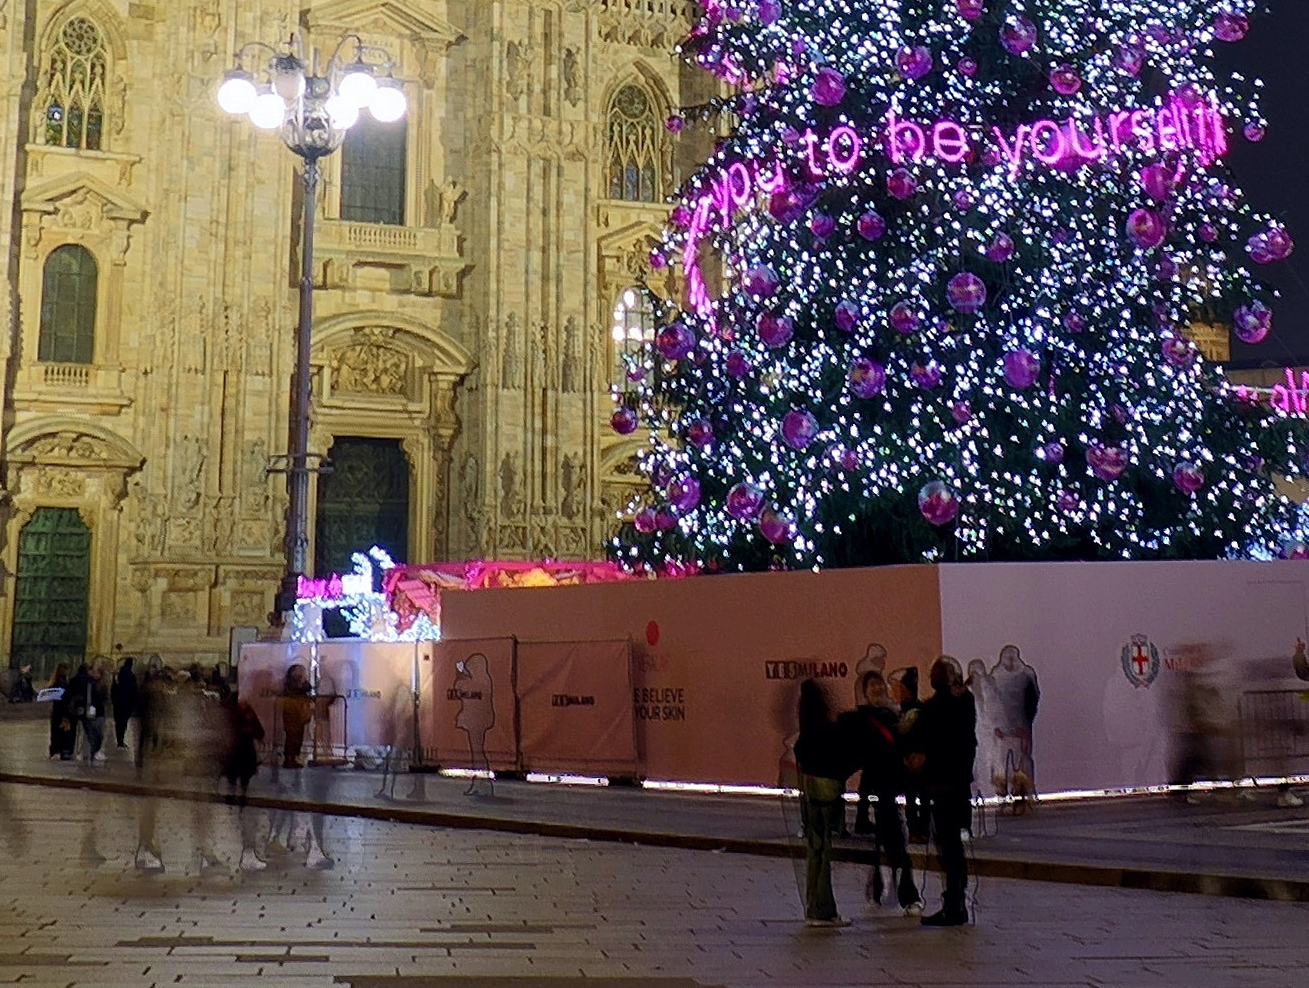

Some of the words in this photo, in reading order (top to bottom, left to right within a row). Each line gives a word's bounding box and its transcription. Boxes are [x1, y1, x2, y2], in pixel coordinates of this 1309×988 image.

[800, 126, 863, 177] to
[888, 106, 968, 164] be
[642, 687, 685, 703] BELIEVE
[662, 705, 686, 721] SKIN
